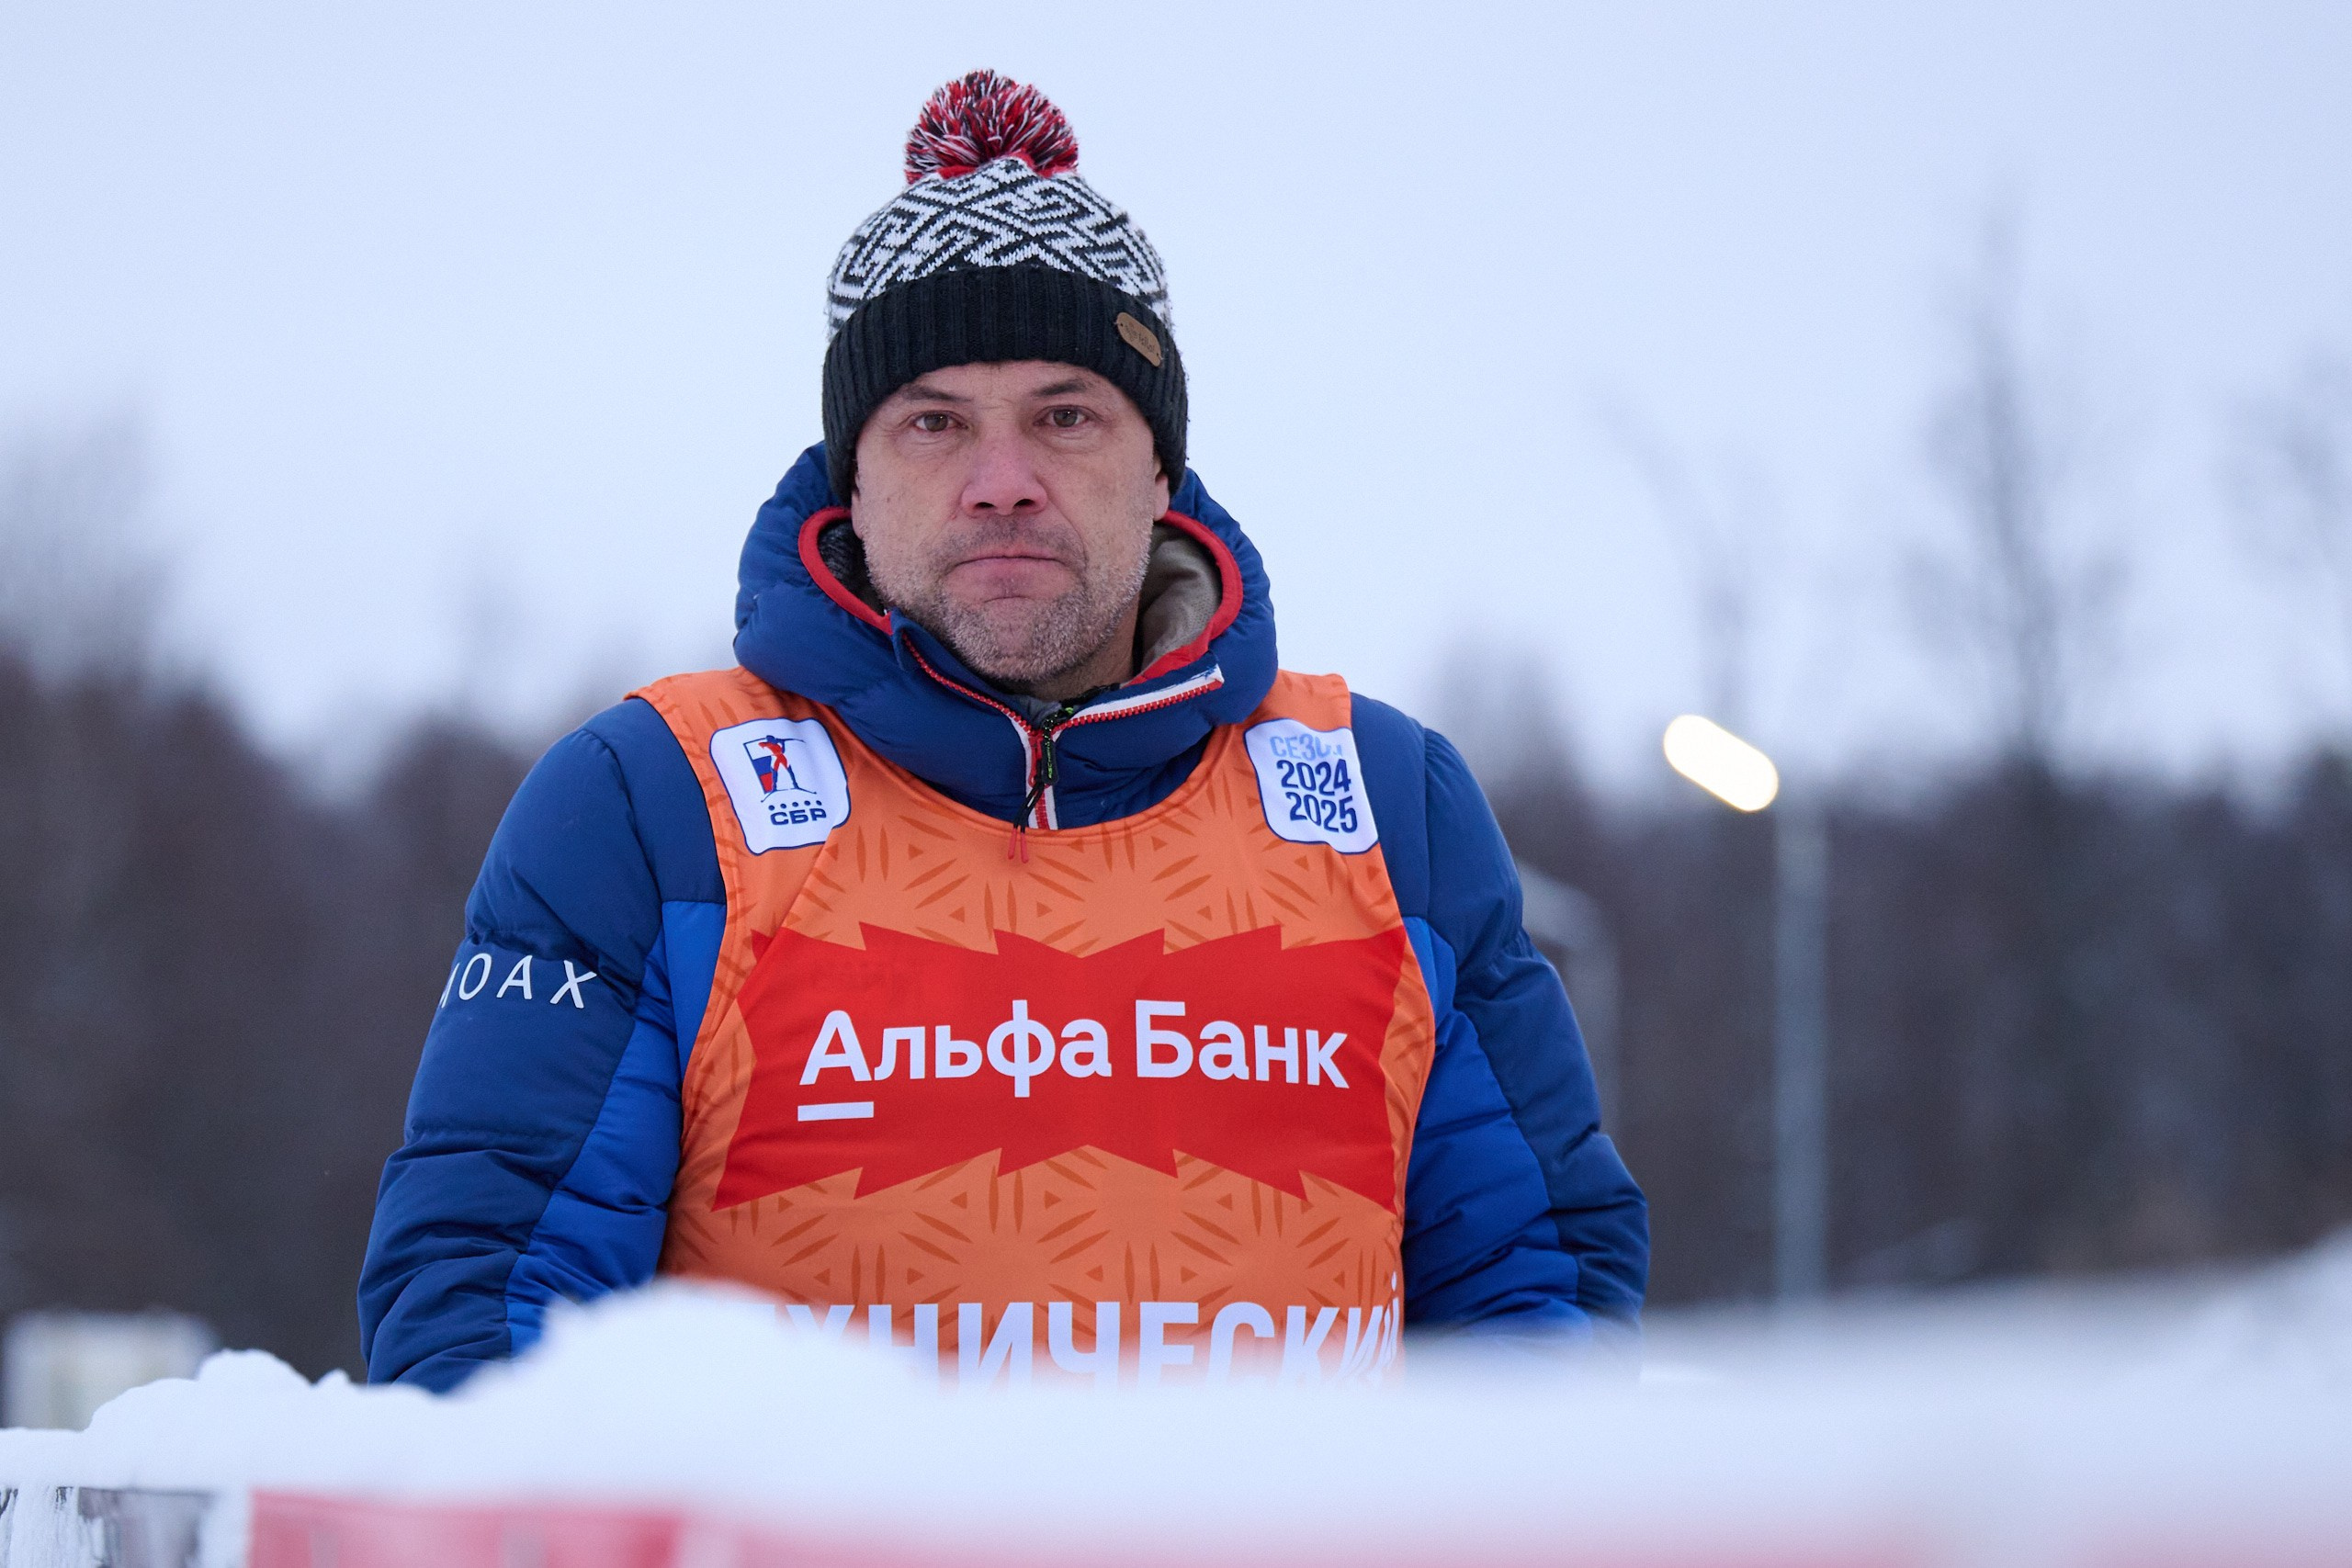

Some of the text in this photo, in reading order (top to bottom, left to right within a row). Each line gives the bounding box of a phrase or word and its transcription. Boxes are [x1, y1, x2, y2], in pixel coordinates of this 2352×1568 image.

[1276, 759, 1351, 796] 2024
[770, 807, 827, 826] СБР
[1285, 792, 1357, 833] 2025
[799, 999, 1350, 1098] Альфа Банк
[770, 1271, 1399, 1387] НИЧЕСКИЙ
